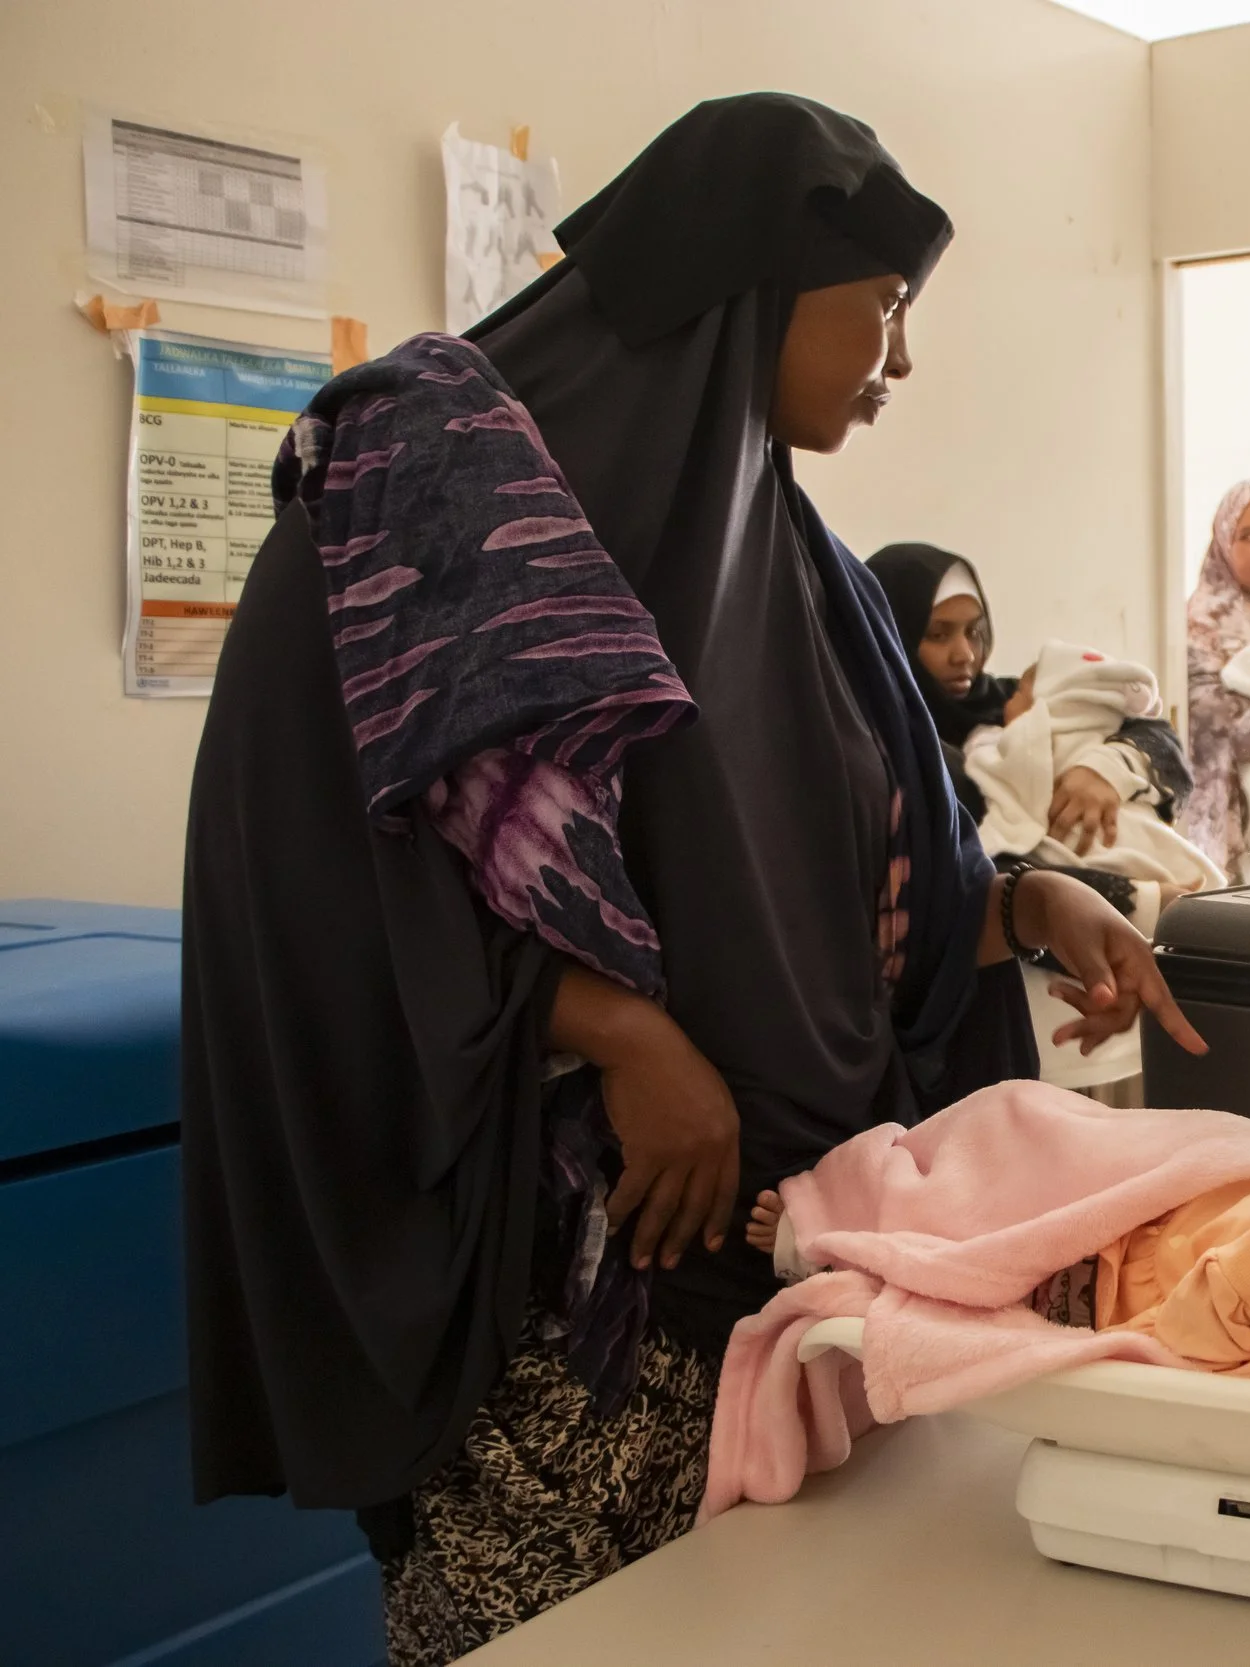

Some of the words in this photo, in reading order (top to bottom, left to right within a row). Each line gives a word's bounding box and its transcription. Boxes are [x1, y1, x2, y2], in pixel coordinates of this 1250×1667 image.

[139, 413, 162, 426] BCG
[140, 454, 176, 467] OPV-0
[141, 495, 165, 507] OPV
[169, 497, 186, 510] 1,2
[190, 498, 199, 509] &
[202, 499, 209, 510] 3
[142, 537, 167, 551] DPT,
[170, 539, 193, 552] Hep
[196, 540, 206, 553] B,
[143, 555, 163, 568] Hib
[167, 557, 183, 570] 1,2
[187, 558, 195, 568] &
[199, 559, 205, 569] 3
[143, 572, 201, 586] Jadeecada
